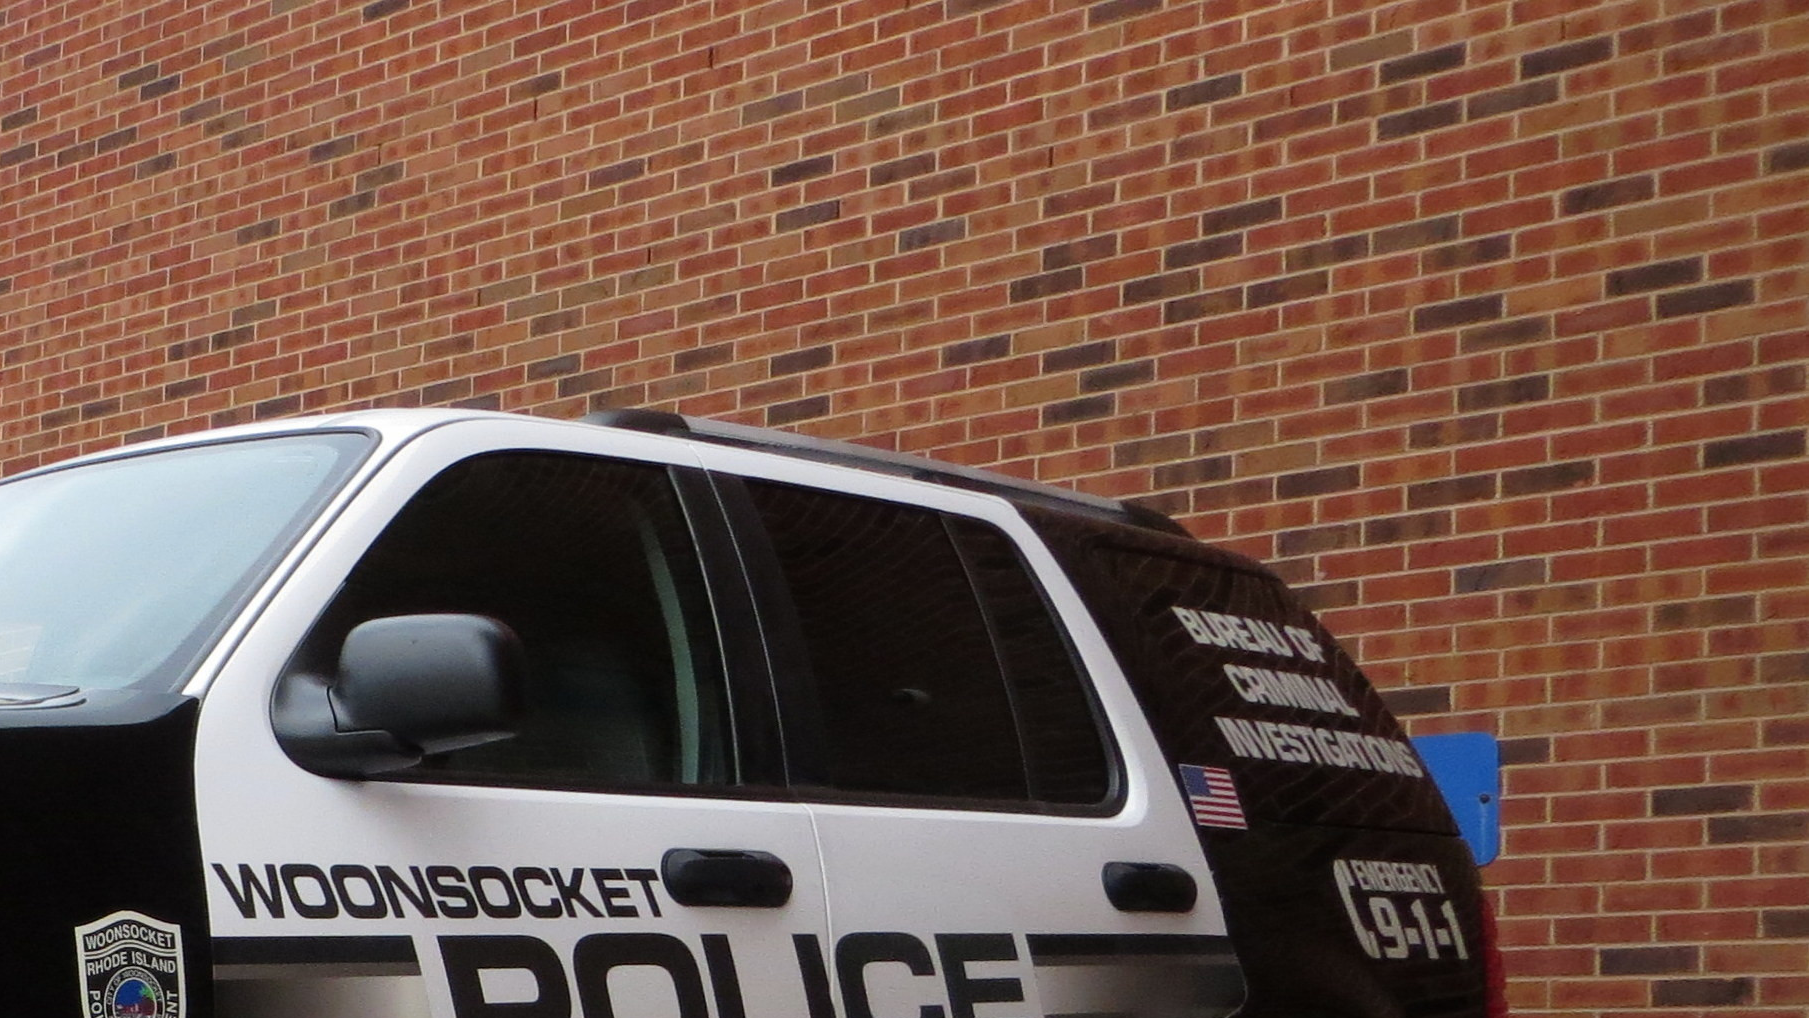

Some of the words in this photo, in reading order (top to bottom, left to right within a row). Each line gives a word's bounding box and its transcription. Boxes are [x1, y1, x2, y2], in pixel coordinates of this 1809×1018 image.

[1171, 606, 1294, 658] BUREAU
[1284, 624, 1327, 664] OF
[1223, 663, 1361, 718] CRIMINAL
[1214, 716, 1425, 779] INVESTIGATIONS
[211, 862, 668, 919] WOONSOCKET
[1350, 859, 1446, 894] EMERGENCY
[85, 923, 173, 950] WOONSOCKET
[1368, 896, 1469, 960] 9-1-1
[87, 951, 128, 976] RHODE
[131, 950, 177, 974] ISLAND
